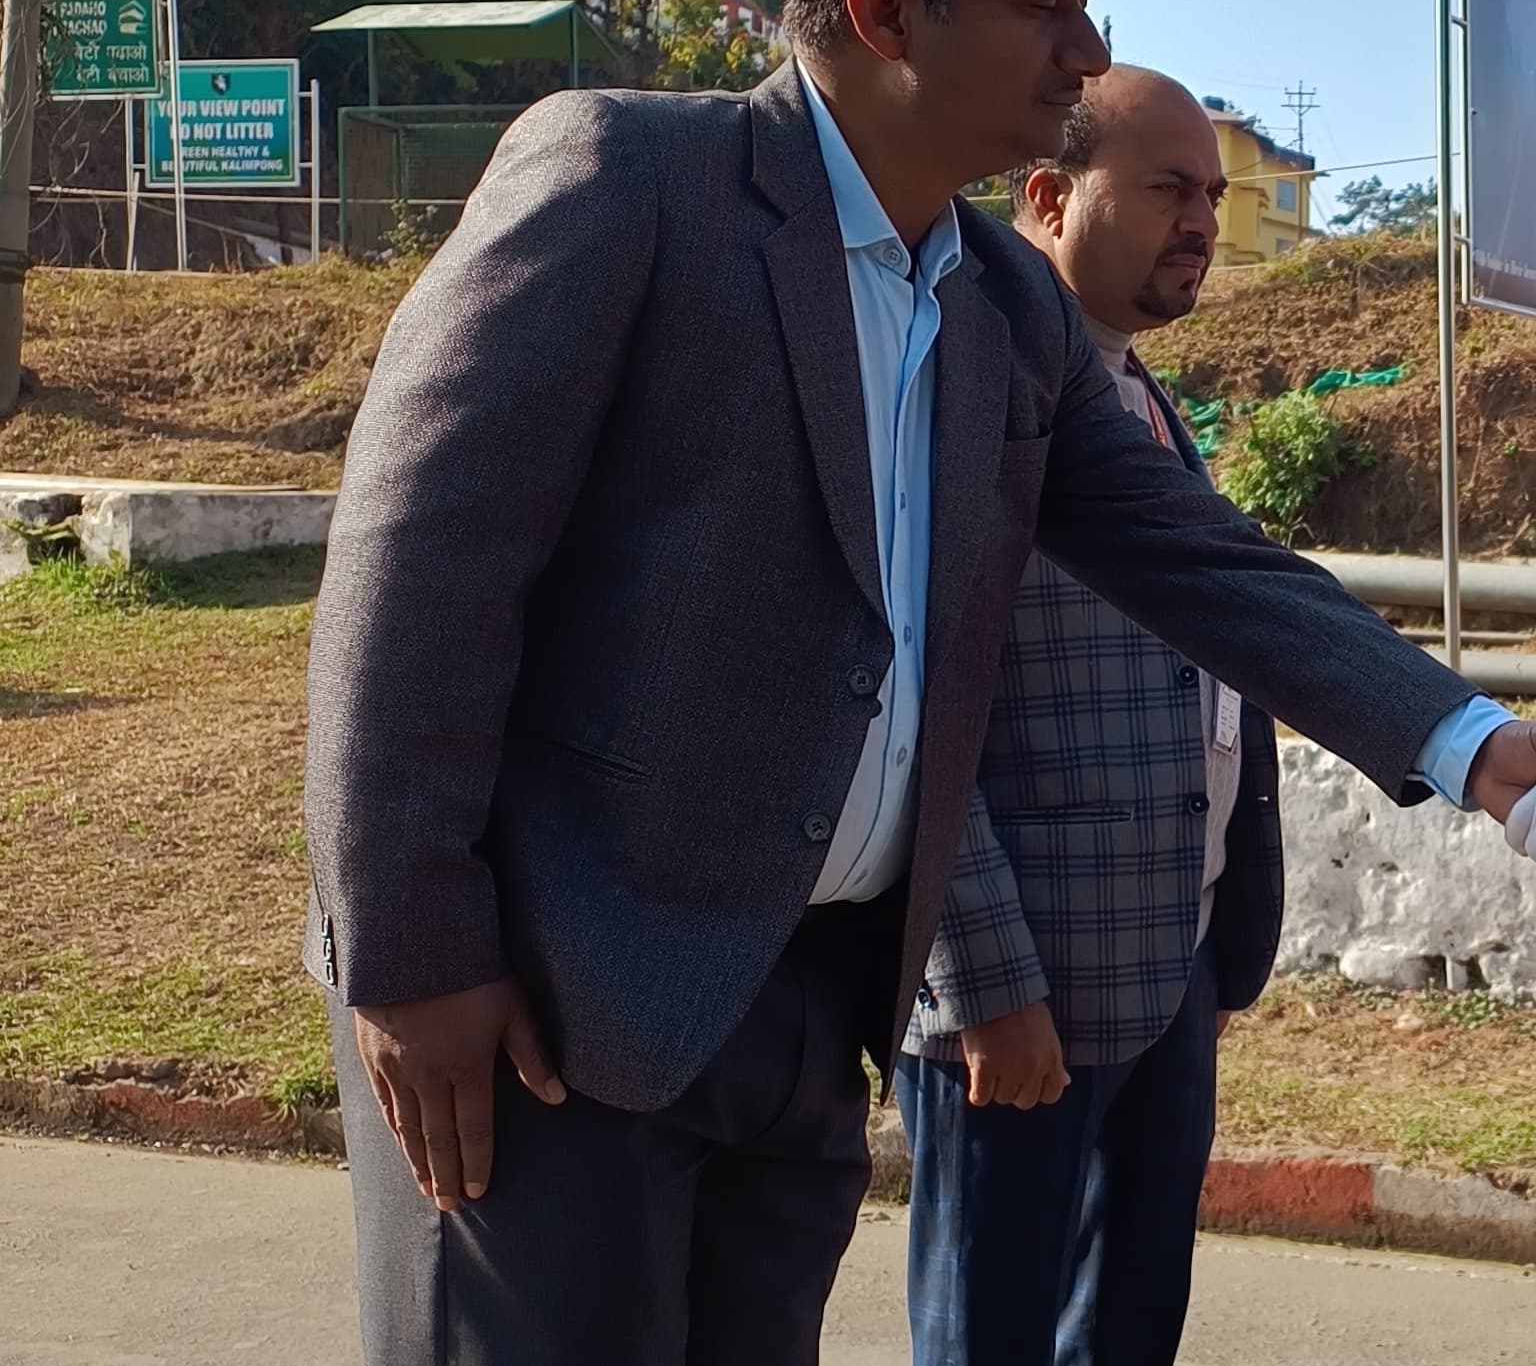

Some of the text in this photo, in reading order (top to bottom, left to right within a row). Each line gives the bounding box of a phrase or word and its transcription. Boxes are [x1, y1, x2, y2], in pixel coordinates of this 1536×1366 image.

[200, 99, 239, 117] VIEW
[241, 98, 286, 116] POINT
[193, 122, 223, 140] NOT
[226, 121, 274, 140] LITTER
[180, 145, 270, 158] REEN HEALTHY &
[161, 158, 283, 173] BEUTIFUL KALIMPONG
